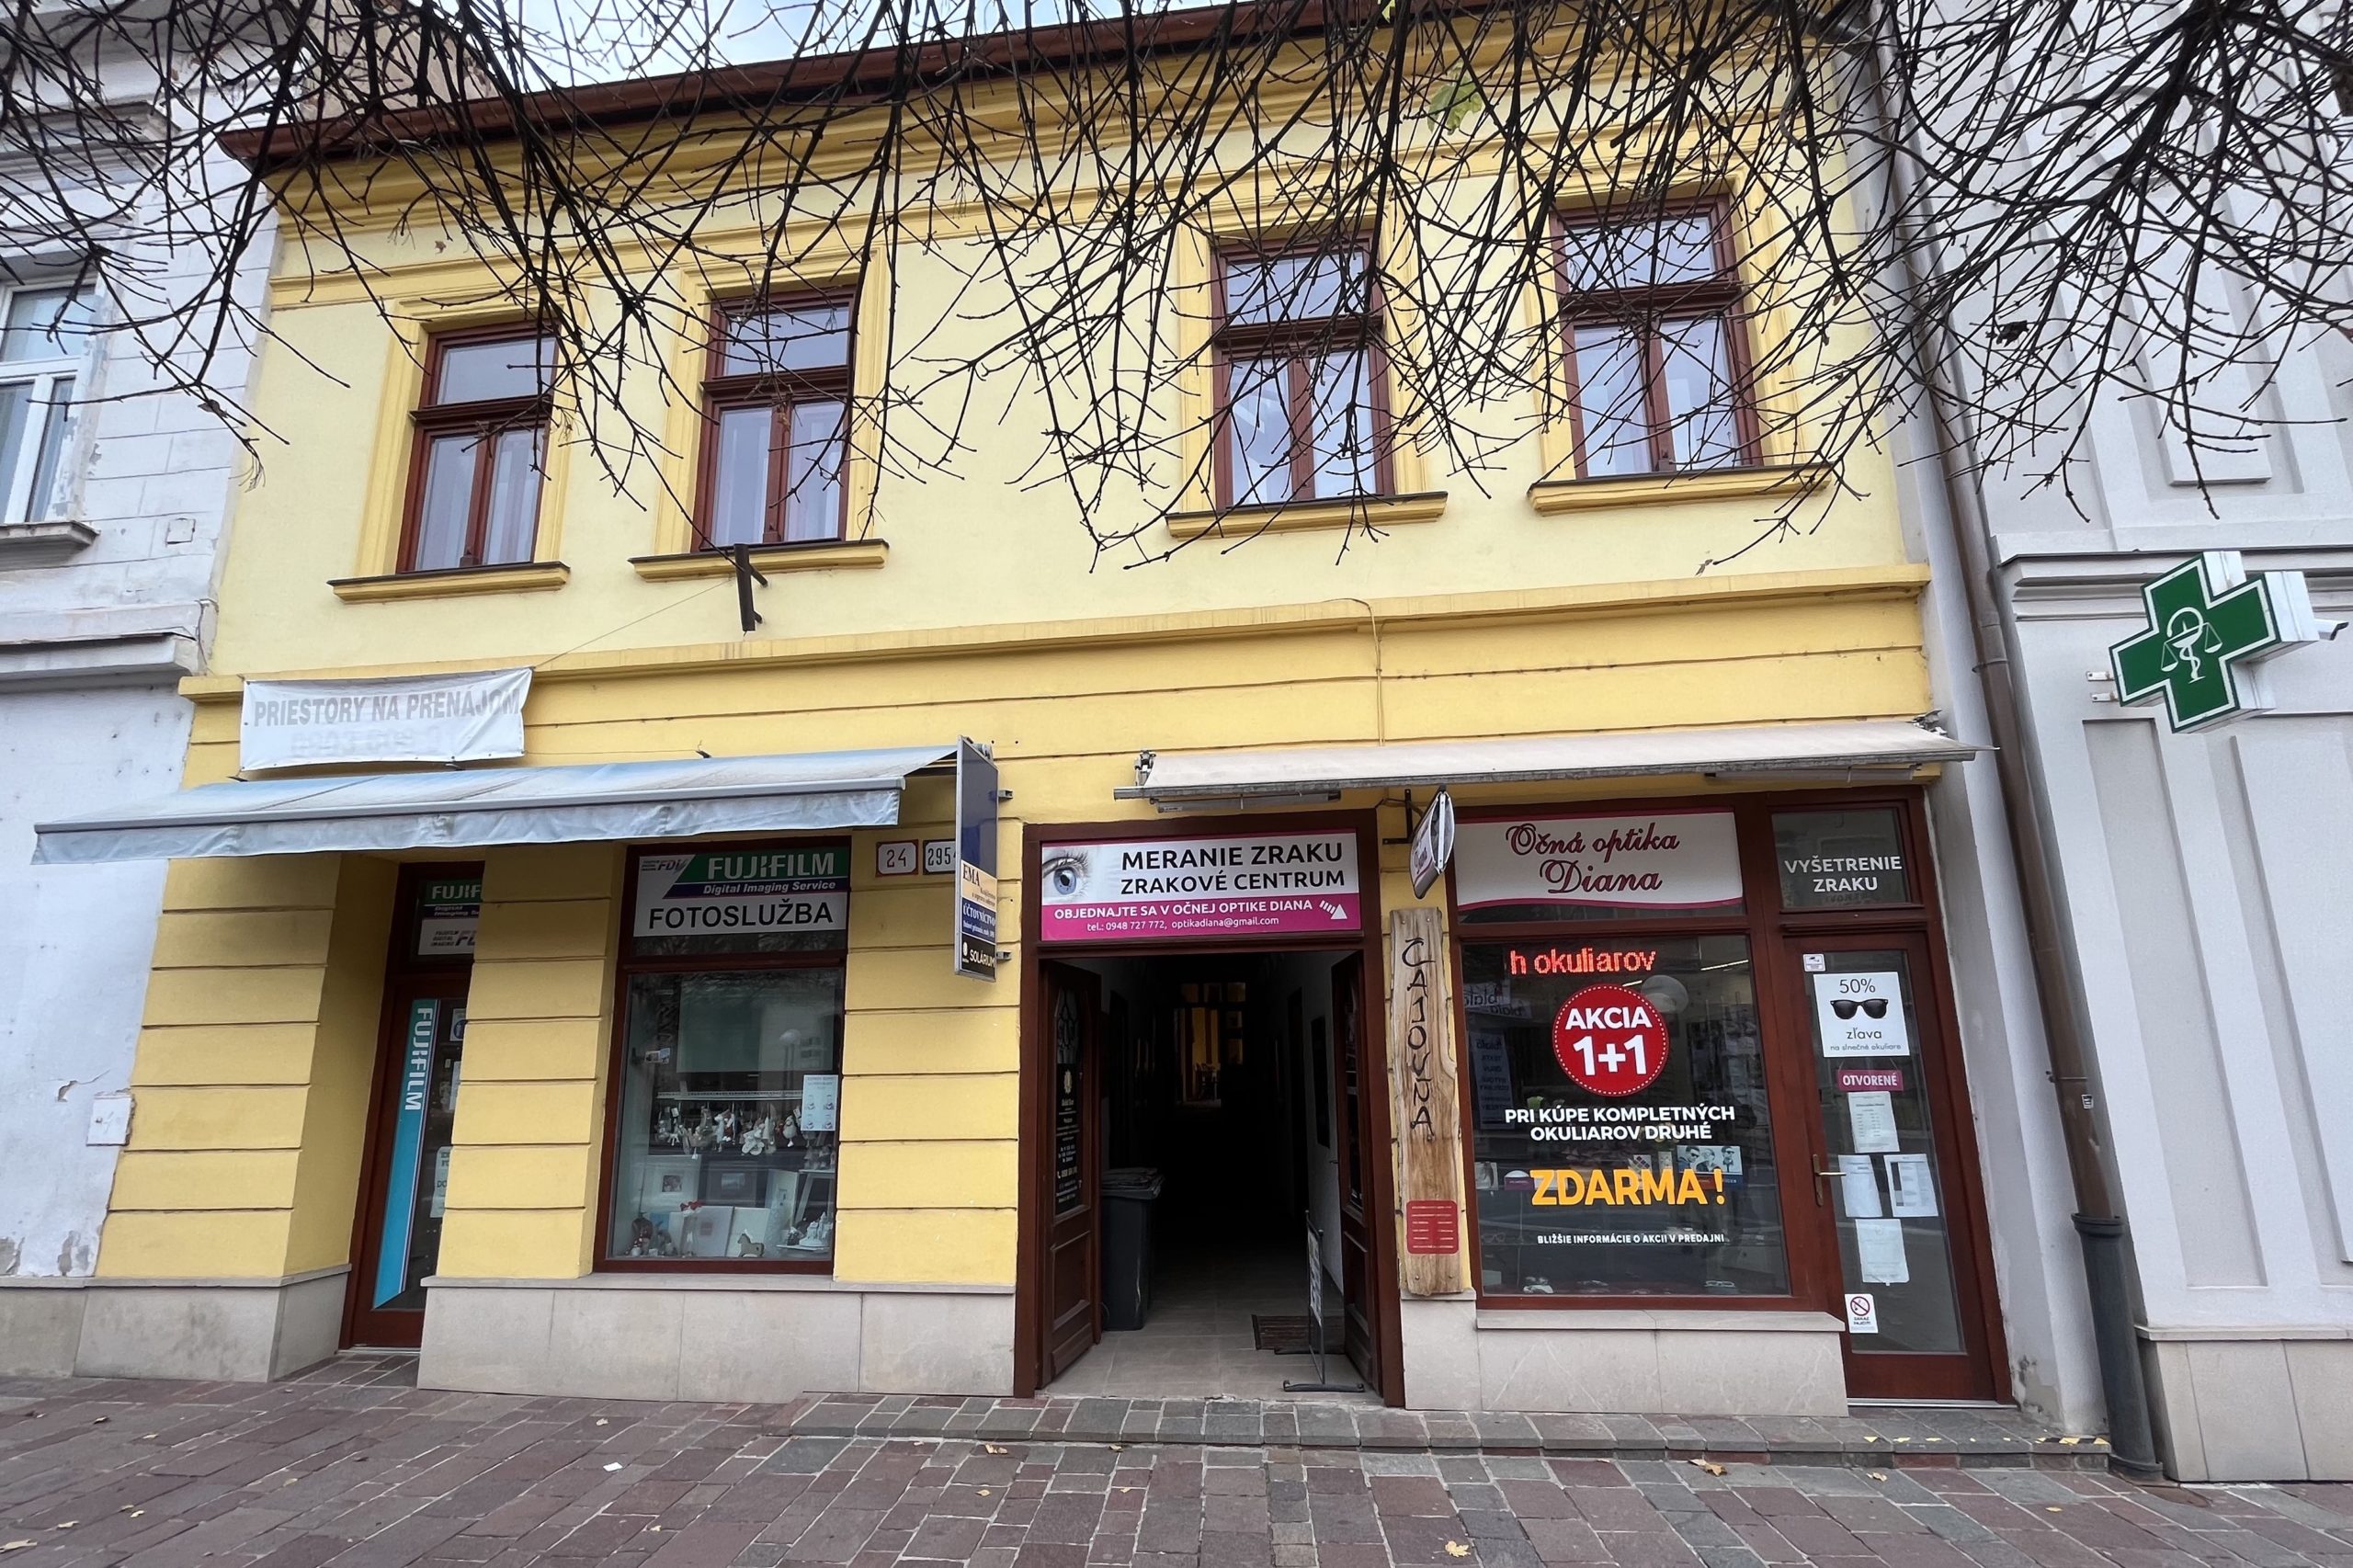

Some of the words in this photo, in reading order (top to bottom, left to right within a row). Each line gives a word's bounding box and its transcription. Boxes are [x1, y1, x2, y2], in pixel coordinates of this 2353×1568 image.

[254, 696, 369, 727] PRIESTORY
[372, 695, 399, 722] NA
[1506, 823, 1586, 856] Očná
[1592, 822, 1680, 863] optika
[708, 853, 835, 880] FUJIFILM
[886, 847, 907, 868] 24
[1121, 847, 1244, 870] MERANIE
[1250, 842, 1343, 865] ZRAKU
[1784, 855, 1903, 873] VYŠETRENIE
[1120, 869, 1227, 895] ZRAKOVÉ
[1233, 869, 1345, 892] CENTRUM
[1540, 858, 1663, 894] Diana
[1813, 877, 1878, 892] ZRAKU
[703, 883, 740, 896] Digital
[743, 881, 789, 894] Imaging
[792, 881, 835, 892] Service
[649, 898, 834, 929] FOTOSLUŽBA
[1054, 905, 1138, 920] OBJEDNAJTE
[1141, 905, 1157, 916] SA
[1160, 905, 1169, 915] V
[1172, 901, 1215, 915] OČNEJ
[1221, 901, 1267, 914] OPTIKE
[1269, 899, 1313, 912] DIANA
[1087, 922, 1104, 931] tel.:
[1106, 921, 1128, 931] 0948
[1129, 920, 1145, 930] 727
[1148, 920, 1167, 930] 772,
[1171, 915, 1279, 929] optikadiana@gmail.com
[1510, 949, 1527, 974] h
[1534, 948, 1656, 975] okuliarov
[1839, 978, 1876, 994] 50%
[1564, 1006, 1653, 1030] AKCIA
[1847, 1027, 1882, 1040] zľava
[1574, 1034, 1647, 1076] 1+1
[1842, 1042, 1870, 1051] slnečné
[1871, 1042, 1902, 1051] okuliare
[404, 1007, 433, 1111] FUJIFILM
[1843, 1073, 1898, 1086] OTVORENÉ
[1505, 1108, 1534, 1123] PRI
[1539, 1105, 1590, 1122] KÚPE
[1594, 1103, 1735, 1122] KOMPLETNÝCH
[1530, 1126, 1641, 1141] OKULIAROV
[1644, 1122, 1712, 1140] DRUHÉ
[1529, 1168, 1708, 1206] ZDARMA
[1537, 1233, 1573, 1244] BLIŽŠIE
[1573, 1233, 1631, 1244] INFORMÁCIE
[1632, 1234, 1641, 1244] O
[1643, 1233, 1668, 1244] AKCII
[1669, 1234, 1677, 1243] V
[1678, 1233, 1724, 1244] PREDAJNI
